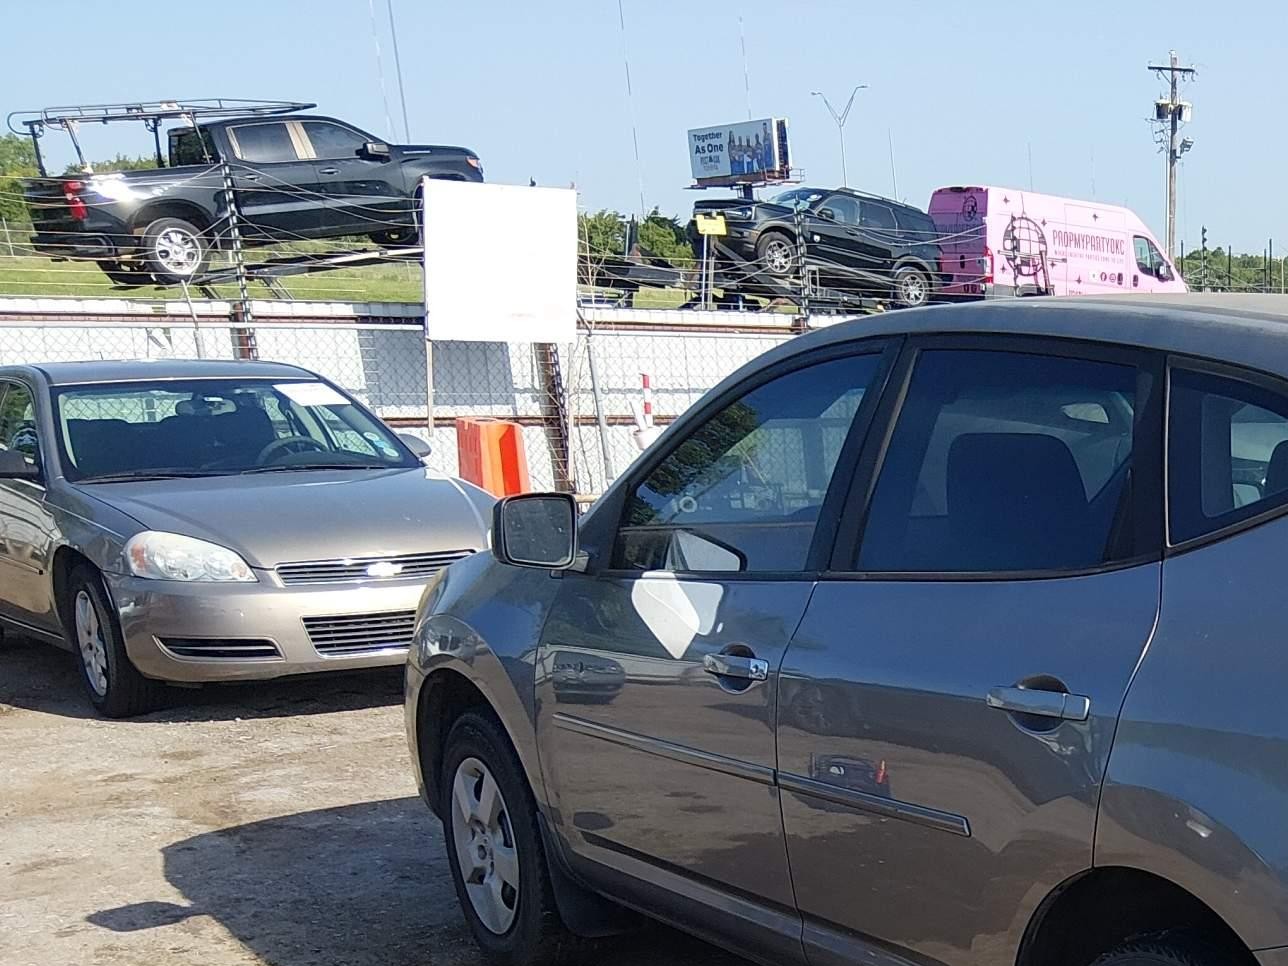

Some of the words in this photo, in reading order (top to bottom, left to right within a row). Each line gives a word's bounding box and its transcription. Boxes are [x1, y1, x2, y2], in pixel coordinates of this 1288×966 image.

[692, 132, 722, 142] Together
[695, 144, 706, 154] As
[707, 143, 723, 153] One
[1053, 230, 1125, 255] PROPMYPARTYOKC
